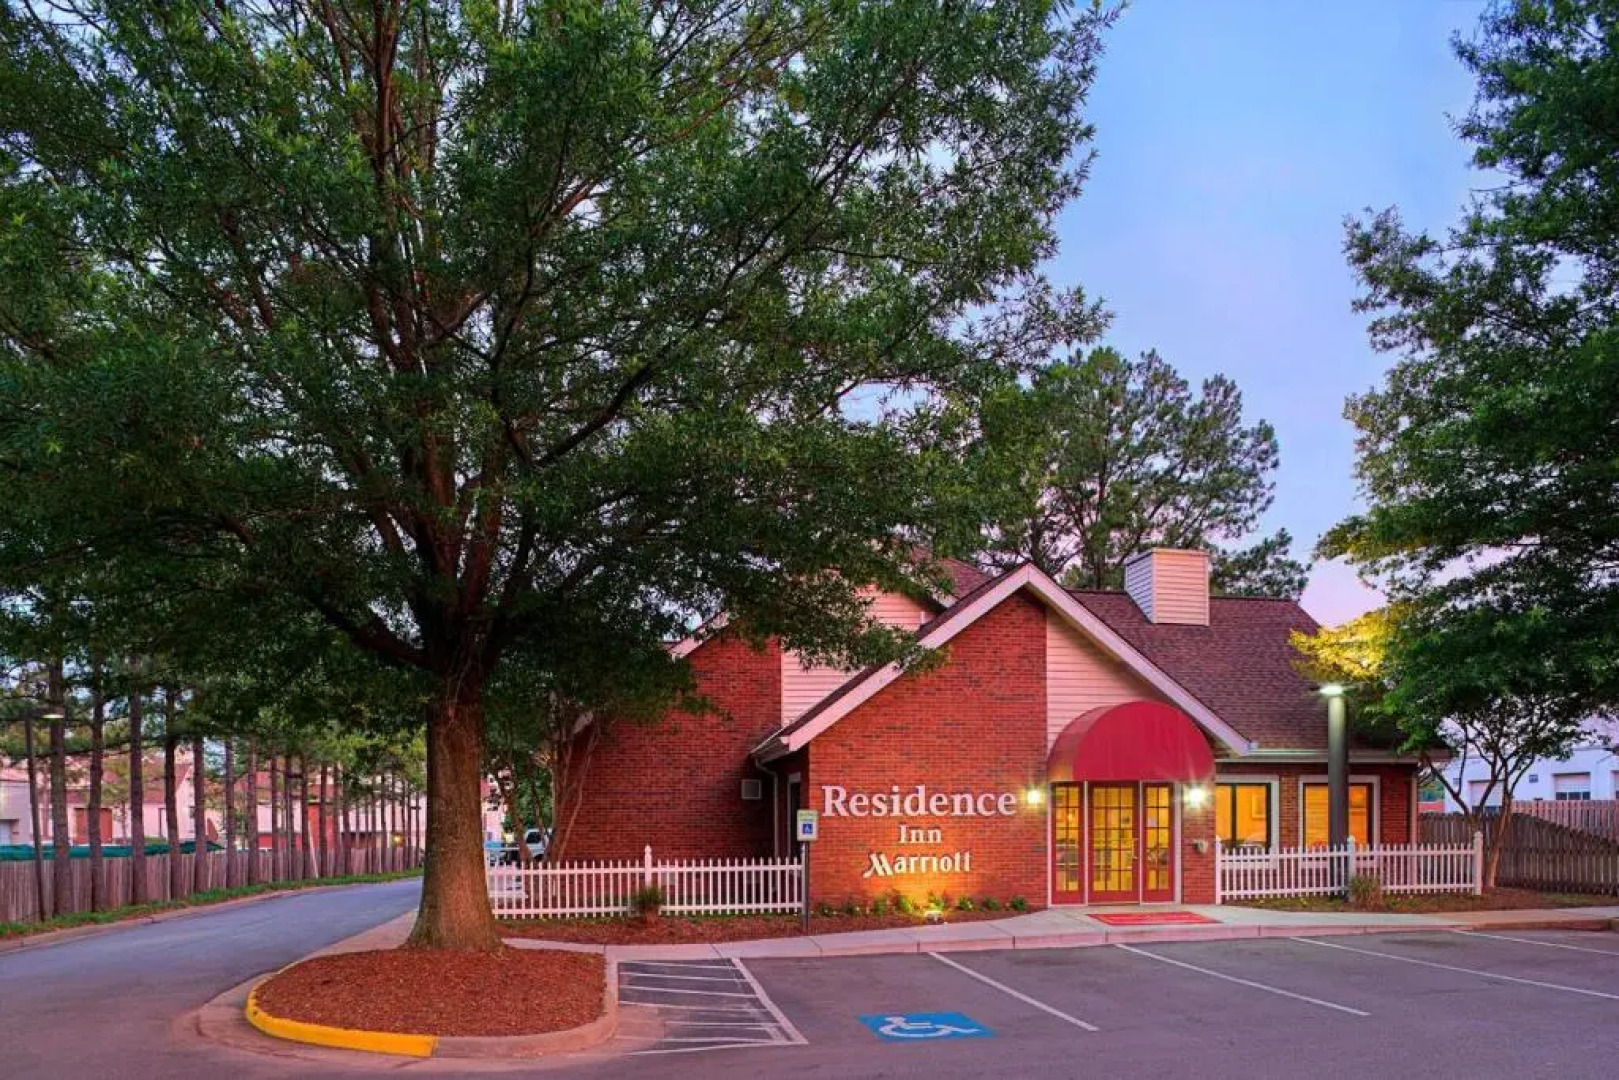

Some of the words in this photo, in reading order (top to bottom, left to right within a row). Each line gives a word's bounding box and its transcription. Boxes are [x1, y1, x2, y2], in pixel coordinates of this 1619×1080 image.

[821, 785, 1017, 817] Residence
[898, 825, 942, 844] Inn
[863, 851, 971, 878] Marriott
